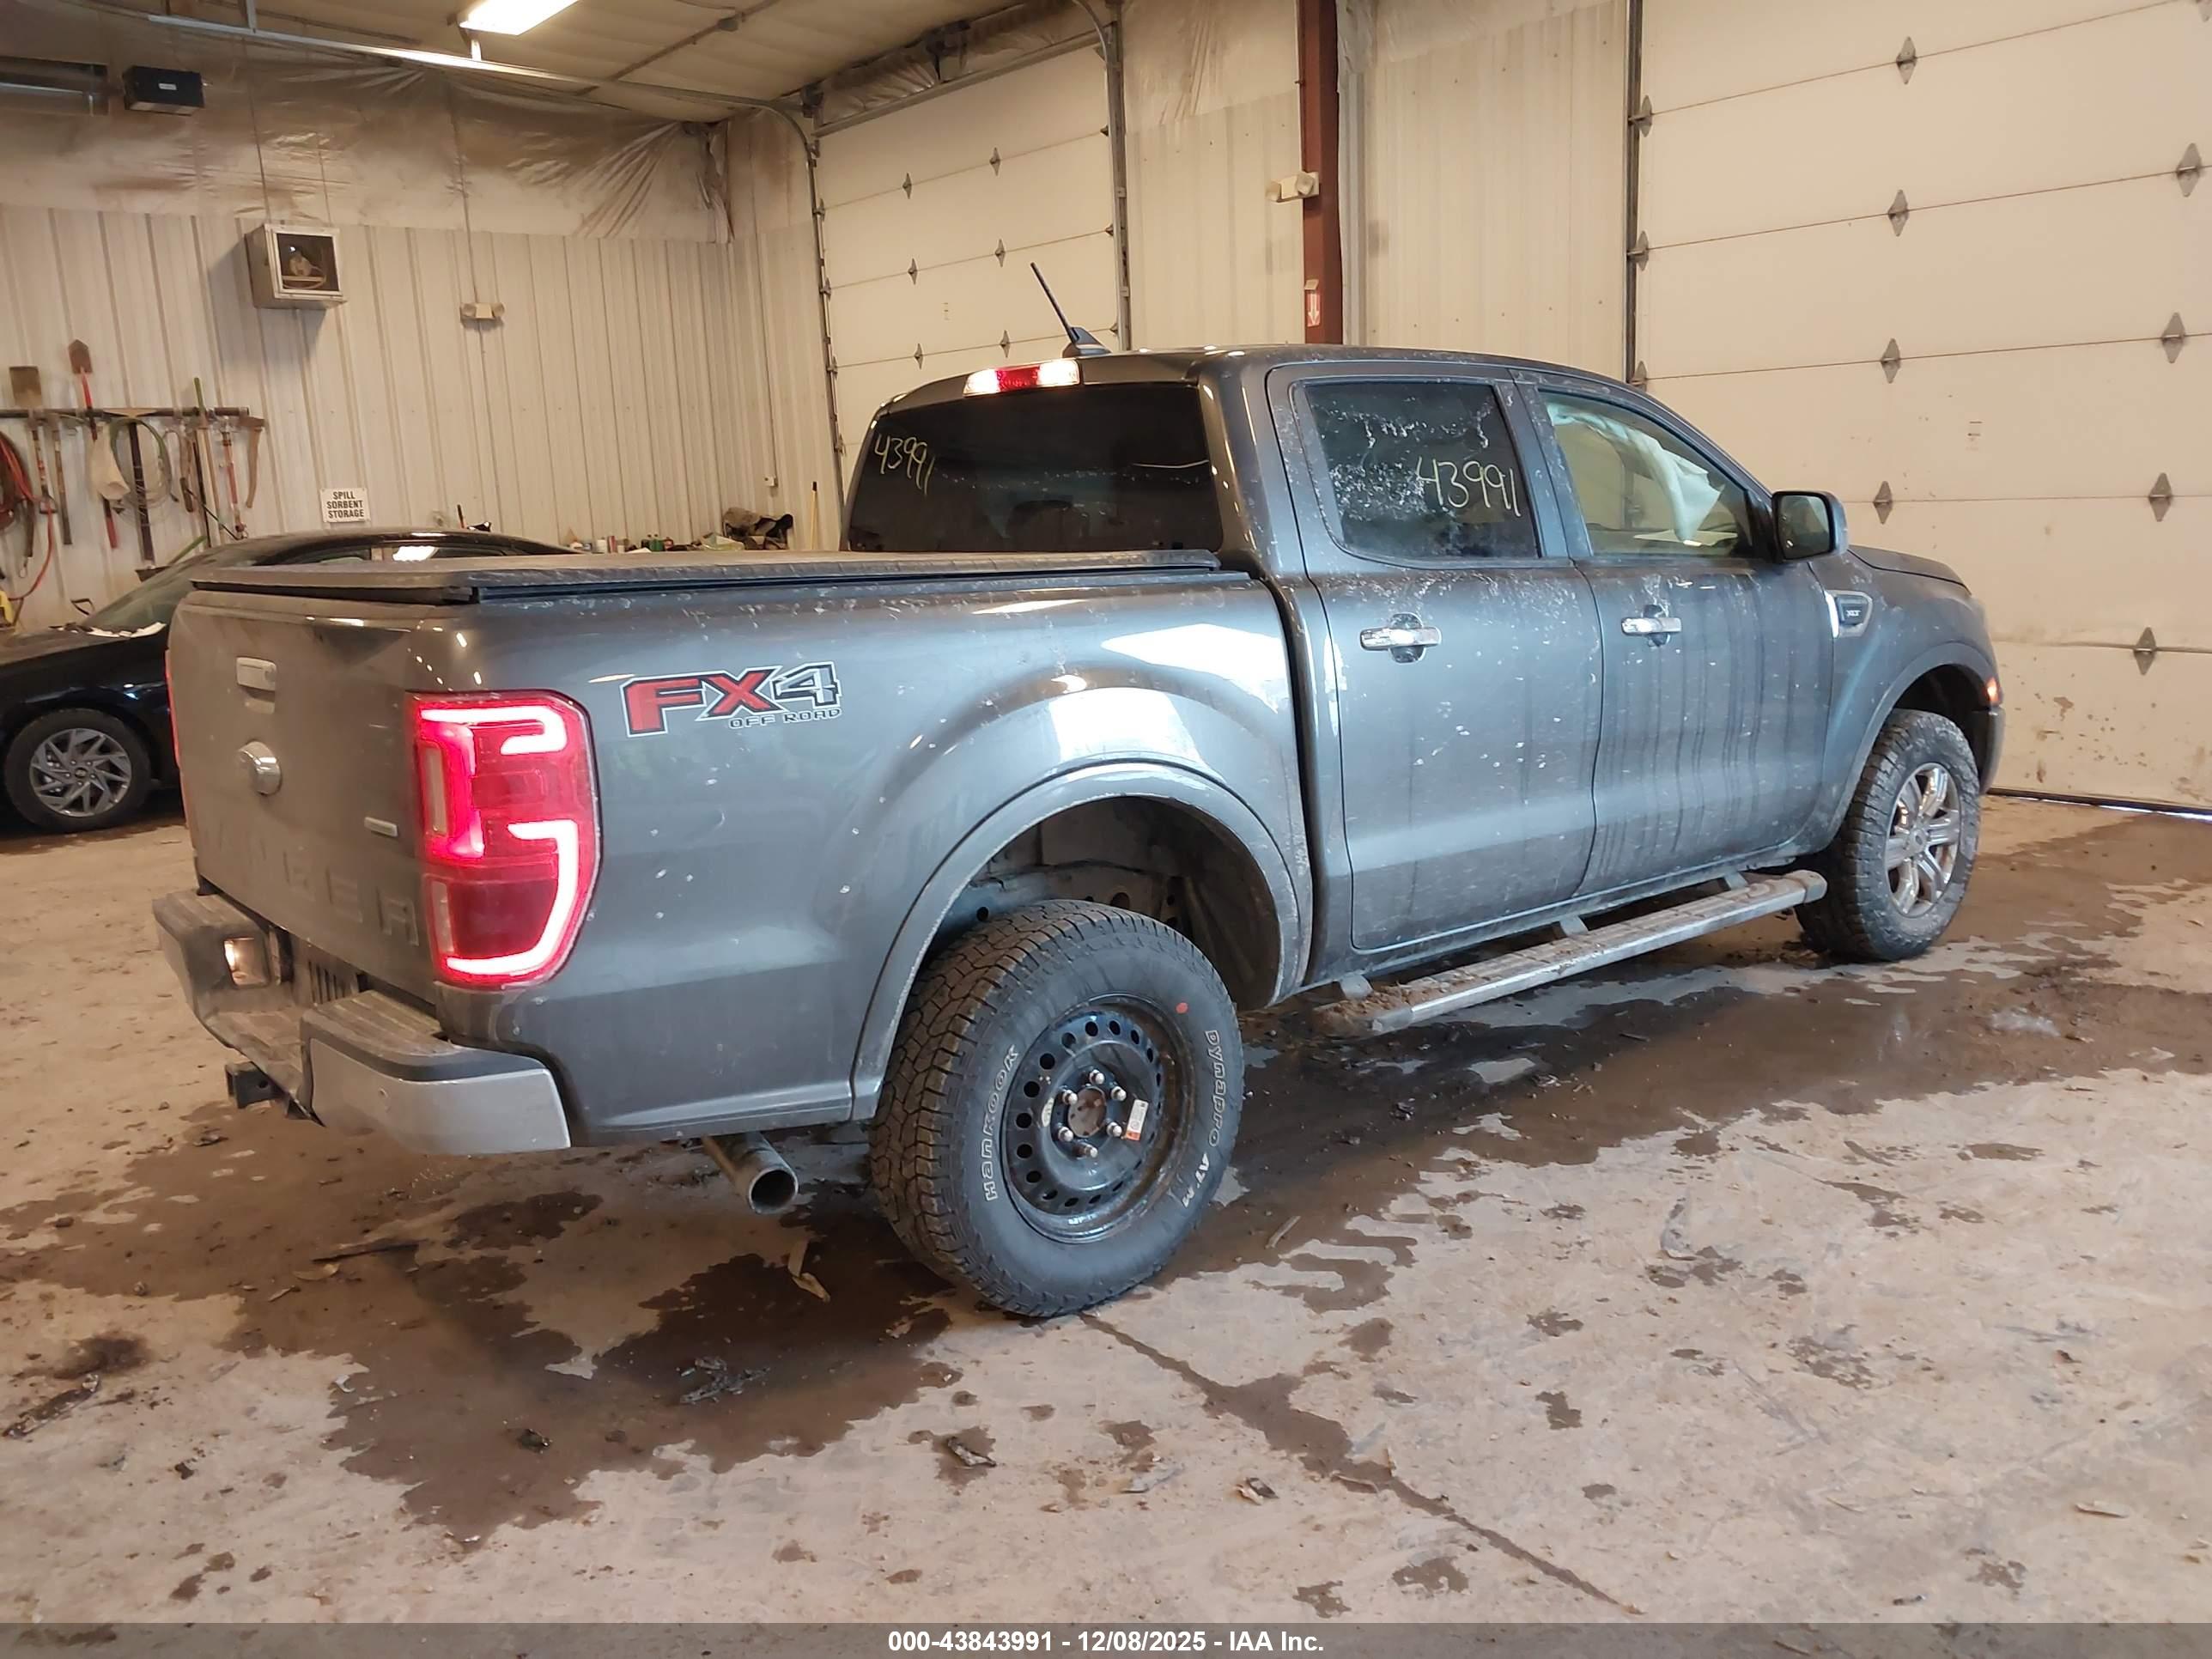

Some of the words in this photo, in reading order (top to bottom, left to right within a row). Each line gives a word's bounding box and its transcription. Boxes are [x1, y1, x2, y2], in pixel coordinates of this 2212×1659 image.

[874, 434, 935, 496] 43991
[332, 491, 356, 500] SPILL
[1416, 456, 1522, 517] 43991
[326, 500, 363, 509] SORBENT
[328, 509, 364, 519] STORAGE
[620, 661, 842, 738] FX4
[729, 717, 776, 730] OFF
[782, 708, 842, 725] ROAD
